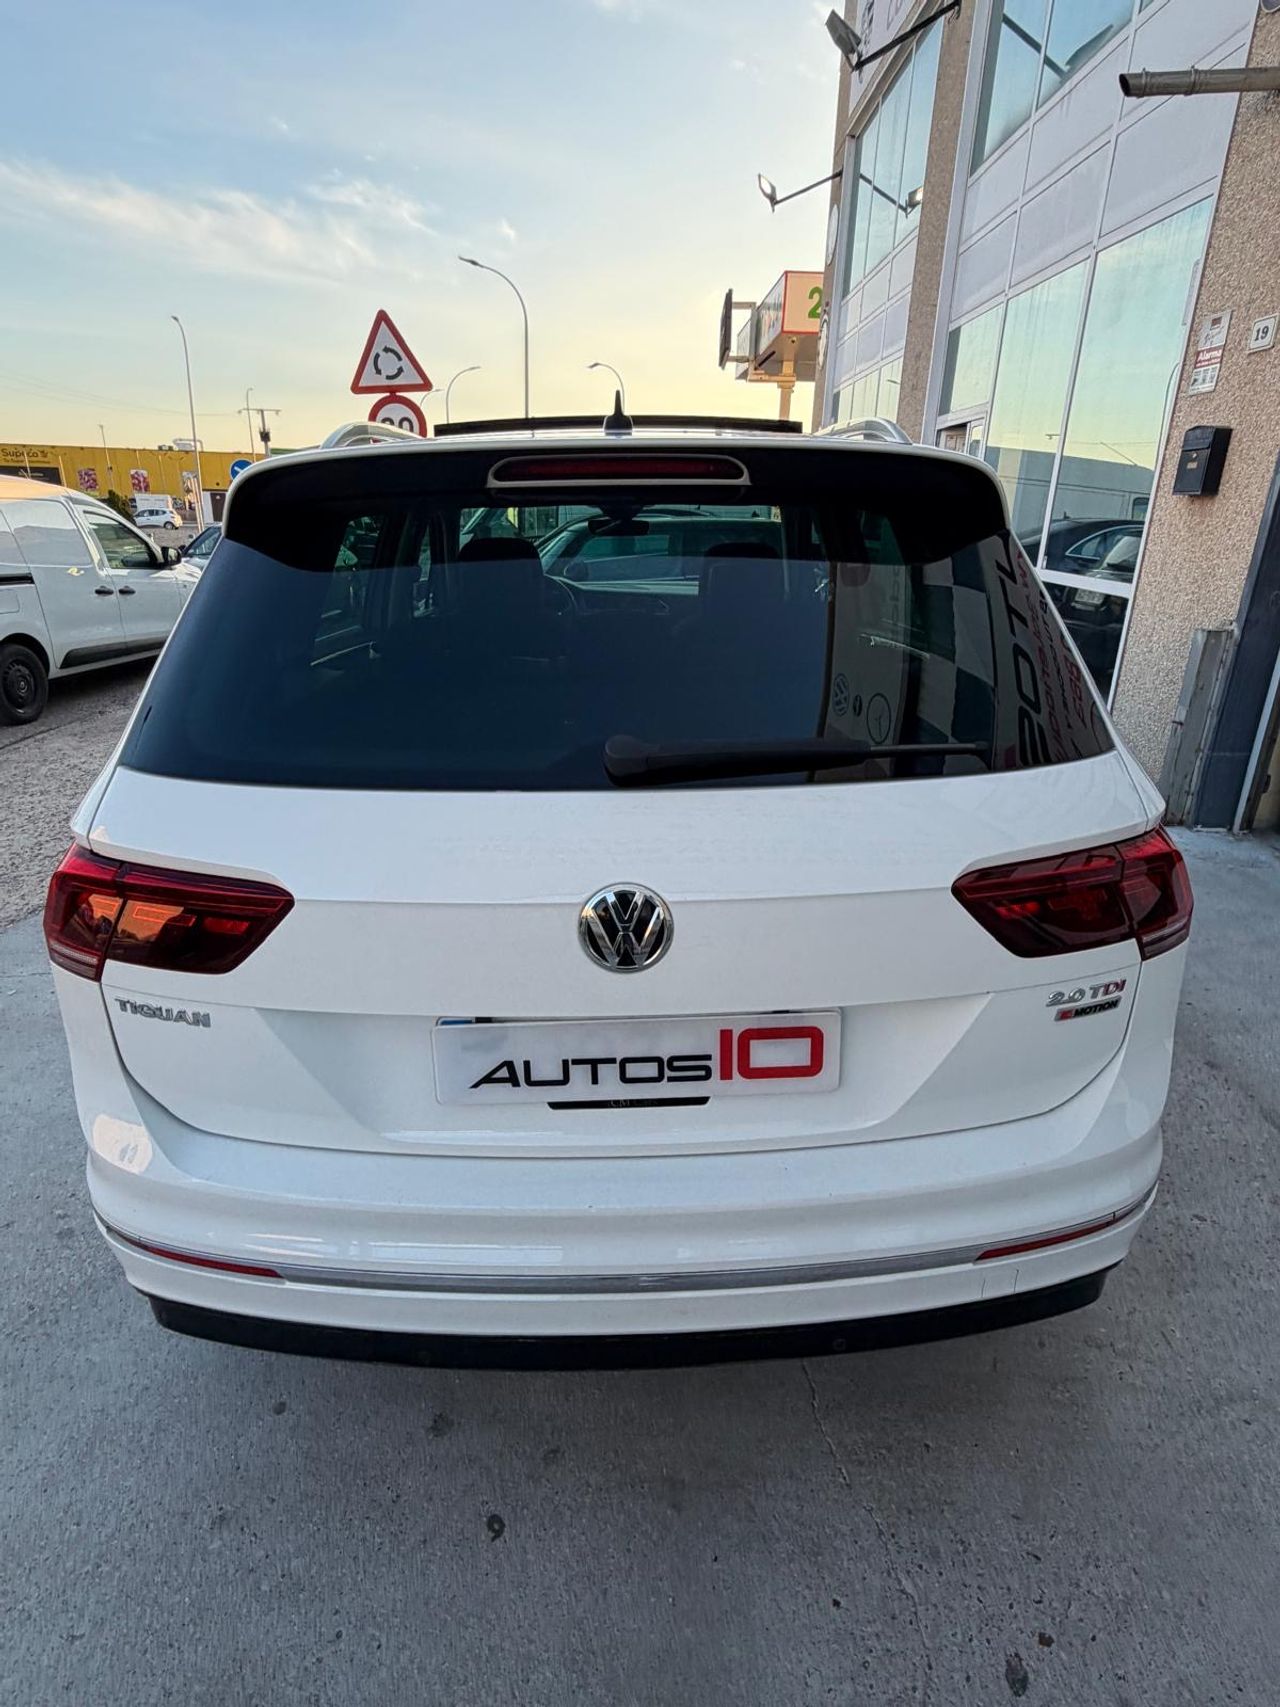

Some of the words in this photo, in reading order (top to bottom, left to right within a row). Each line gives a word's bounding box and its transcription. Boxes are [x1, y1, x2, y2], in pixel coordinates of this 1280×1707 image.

[808, 286, 823, 319] 2
[1254, 325, 1270, 341] 19
[1046, 988, 1086, 1007] 2.0
[1089, 979, 1127, 999] TDI
[114, 997, 212, 1028] TIGUAN
